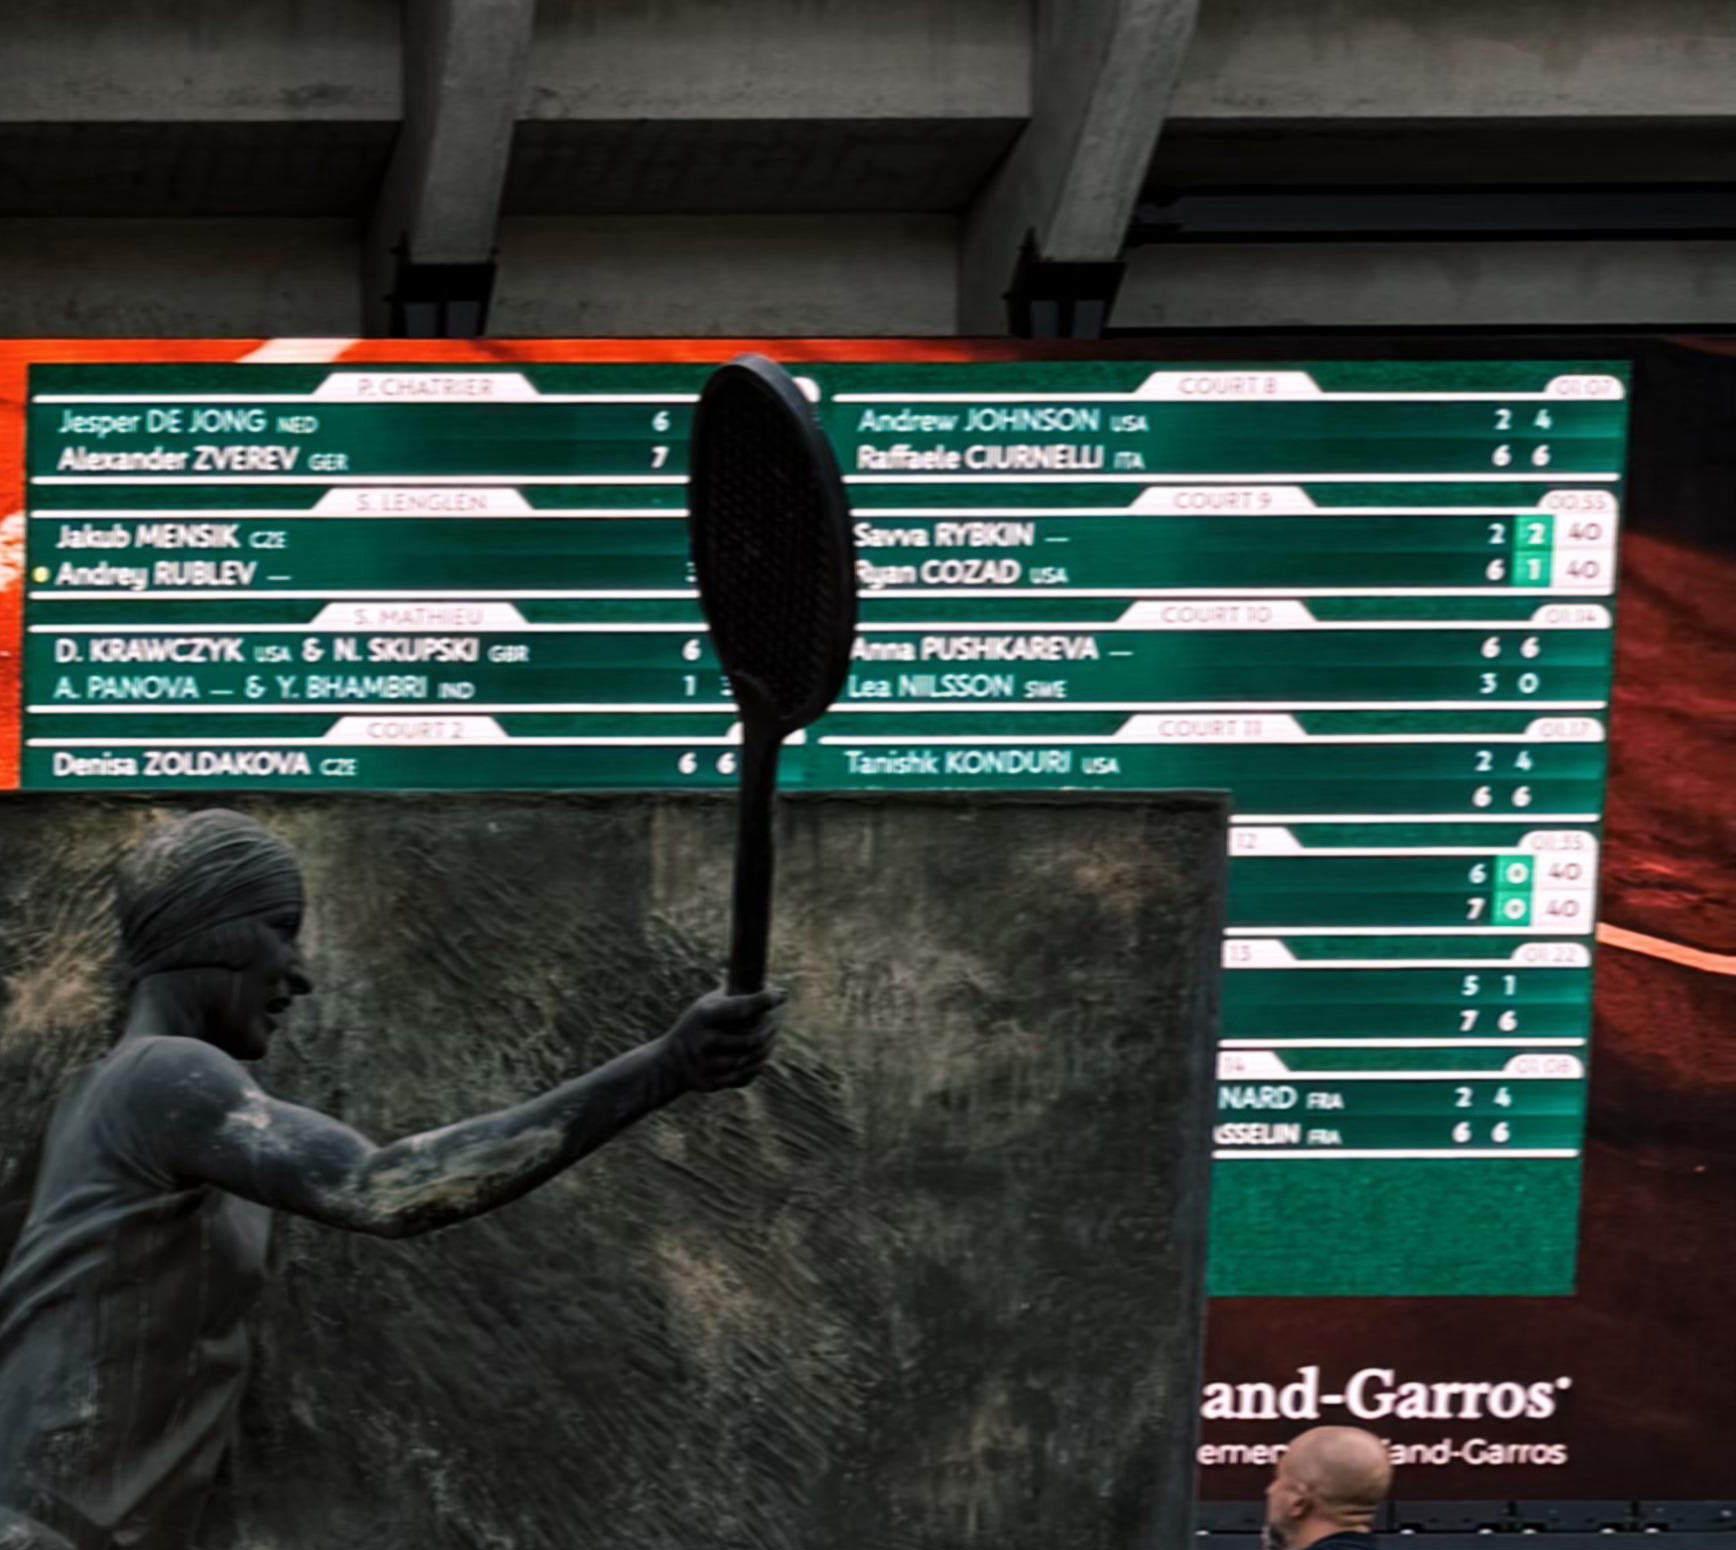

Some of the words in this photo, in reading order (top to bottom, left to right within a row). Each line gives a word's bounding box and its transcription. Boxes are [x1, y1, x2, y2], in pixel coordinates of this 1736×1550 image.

[379, 378, 494, 396] CHATRIER
[1178, 376, 1257, 395] COURT
[57, 410, 140, 437] Jesper
[147, 410, 182, 432] DE
[188, 410, 267, 432] JONG
[276, 416, 318, 433] NED
[652, 410, 670, 431] 6
[856, 408, 960, 432] Andrew
[963, 408, 1101, 432] JOHNSON
[1109, 415, 1151, 432] USA
[1493, 408, 1512, 430] 2
[1533, 408, 1553, 430] 4
[57, 446, 188, 471] Alexander
[192, 446, 300, 471] ZVEREV
[308, 453, 349, 471] GER
[650, 446, 669, 468] 7
[856, 445, 961, 470] Raffaele
[1113, 451, 1147, 470] ITA
[1492, 444, 1511, 467] 6
[1531, 444, 1551, 467] 6
[381, 493, 488, 511] LENGLEN
[1173, 491, 1252, 511] COURT
[1259, 491, 1273, 511] 9
[55, 524, 131, 549] Jakub
[134, 524, 241, 548] MENSIK
[249, 531, 288, 548] CZE
[852, 522, 930, 547] Savva
[934, 522, 1036, 547] RYBKIN
[1487, 523, 1506, 545] 2
[1526, 523, 1545, 545] 2
[1567, 523, 1602, 542] 40
[55, 562, 149, 590] Andrey
[153, 561, 258, 585] RUBLEV
[854, 559, 918, 589] Ryan
[920, 559, 1022, 585] COZAD
[1029, 566, 1070, 584] USA
[1485, 559, 1505, 582] 6
[1525, 559, 1541, 581] 1
[1566, 560, 1601, 580] 40
[377, 608, 484, 626] MATHIEU
[1160, 605, 1240, 625] COURT
[54, 638, 84, 662] D.
[89, 638, 245, 662] KRAWCZYK
[253, 645, 293, 662] USA
[301, 637, 326, 662] &
[333, 638, 362, 662] N.
[367, 637, 480, 662] SKUPSKI
[487, 645, 530, 662] GBR
[682, 638, 702, 661] 6
[849, 636, 917, 661] Anna
[920, 636, 1100, 661] PUSHKAREVA
[1480, 636, 1501, 659] 6
[1520, 636, 1540, 659] 6
[53, 675, 81, 698] A.
[87, 675, 200, 698] PANOVA
[245, 675, 267, 698] &
[275, 675, 300, 698] Y.
[305, 675, 428, 698] BHAMBRI
[438, 682, 475, 699] IND
[682, 675, 697, 697] 1
[847, 674, 893, 698] Lea
[898, 674, 1014, 698] NILSSON
[1023, 681, 1068, 699] SWE
[1479, 672, 1498, 694] 3
[1517, 672, 1540, 694] 0
[367, 721, 445, 739] COURT
[450, 721, 465, 739] 2
[1157, 719, 1237, 738] COURT
[53, 751, 138, 776] Denisa
[142, 751, 312, 776] ZOLDAKOVA
[319, 759, 359, 776] CZE
[678, 752, 698, 775] 6
[716, 752, 737, 775] 6
[844, 750, 940, 775] Tanishk
[945, 749, 1074, 774] KONDURI
[1081, 757, 1121, 775] USA
[1473, 750, 1493, 772] 2
[1513, 750, 1533, 772] 4
[1472, 785, 1493, 807] 6
[1511, 785, 1532, 807] 6
[1468, 863, 1487, 884] 6
[1506, 862, 1529, 885] 0
[1547, 862, 1584, 881] 40
[1466, 897, 1486, 920] 7
[1503, 896, 1527, 920] 0
[1545, 899, 1581, 918] 40
[1461, 974, 1480, 996] 5
[1502, 974, 1516, 996] 1
[1460, 1009, 1479, 1032] 7
[1497, 1010, 1518, 1032] 6
[1217, 1085, 1299, 1110] NARD
[1306, 1091, 1344, 1110] FRA
[1454, 1086, 1473, 1108] 2
[1492, 1086, 1512, 1108] 4
[1213, 1122, 1302, 1145] SSELIN
[1307, 1128, 1342, 1145] FRA
[1451, 1121, 1471, 1144] 6
[1490, 1121, 1511, 1144] 6
[1382, 1437, 1568, 1466] and-Garros
